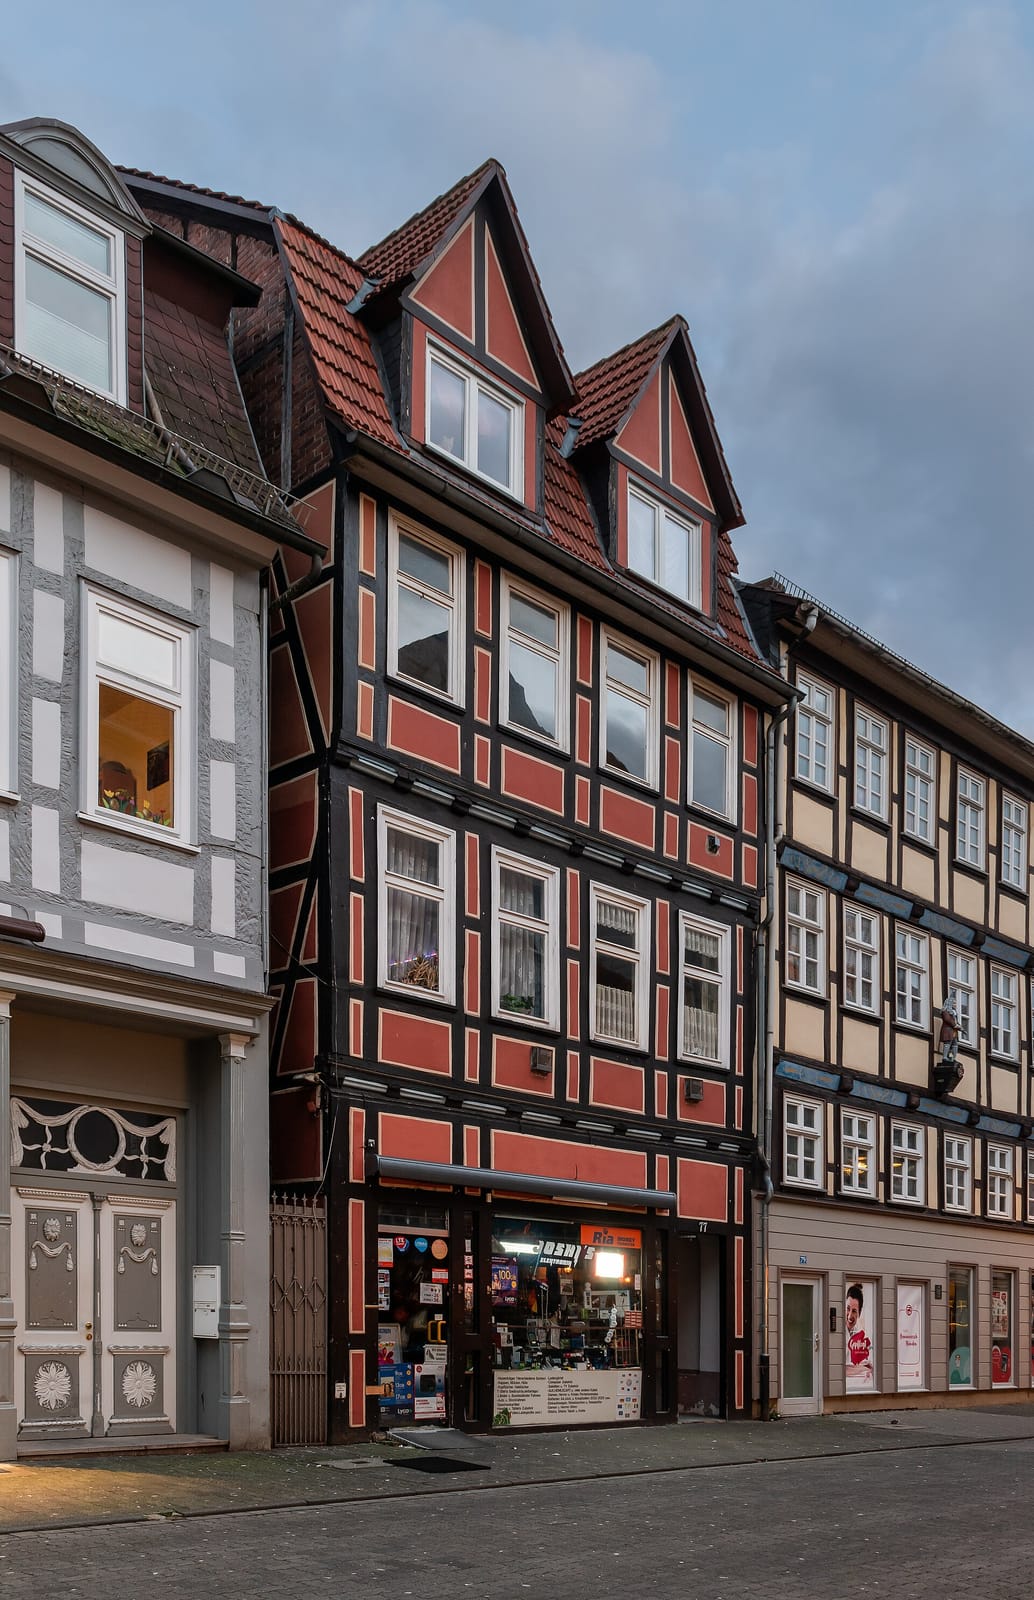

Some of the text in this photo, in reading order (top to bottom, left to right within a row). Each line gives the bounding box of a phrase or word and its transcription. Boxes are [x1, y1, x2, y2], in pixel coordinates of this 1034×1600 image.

[699, 1222, 708, 1232] 77
[592, 1228, 614, 1245] Ria
[537, 1239, 596, 1268] JOSHI'S
